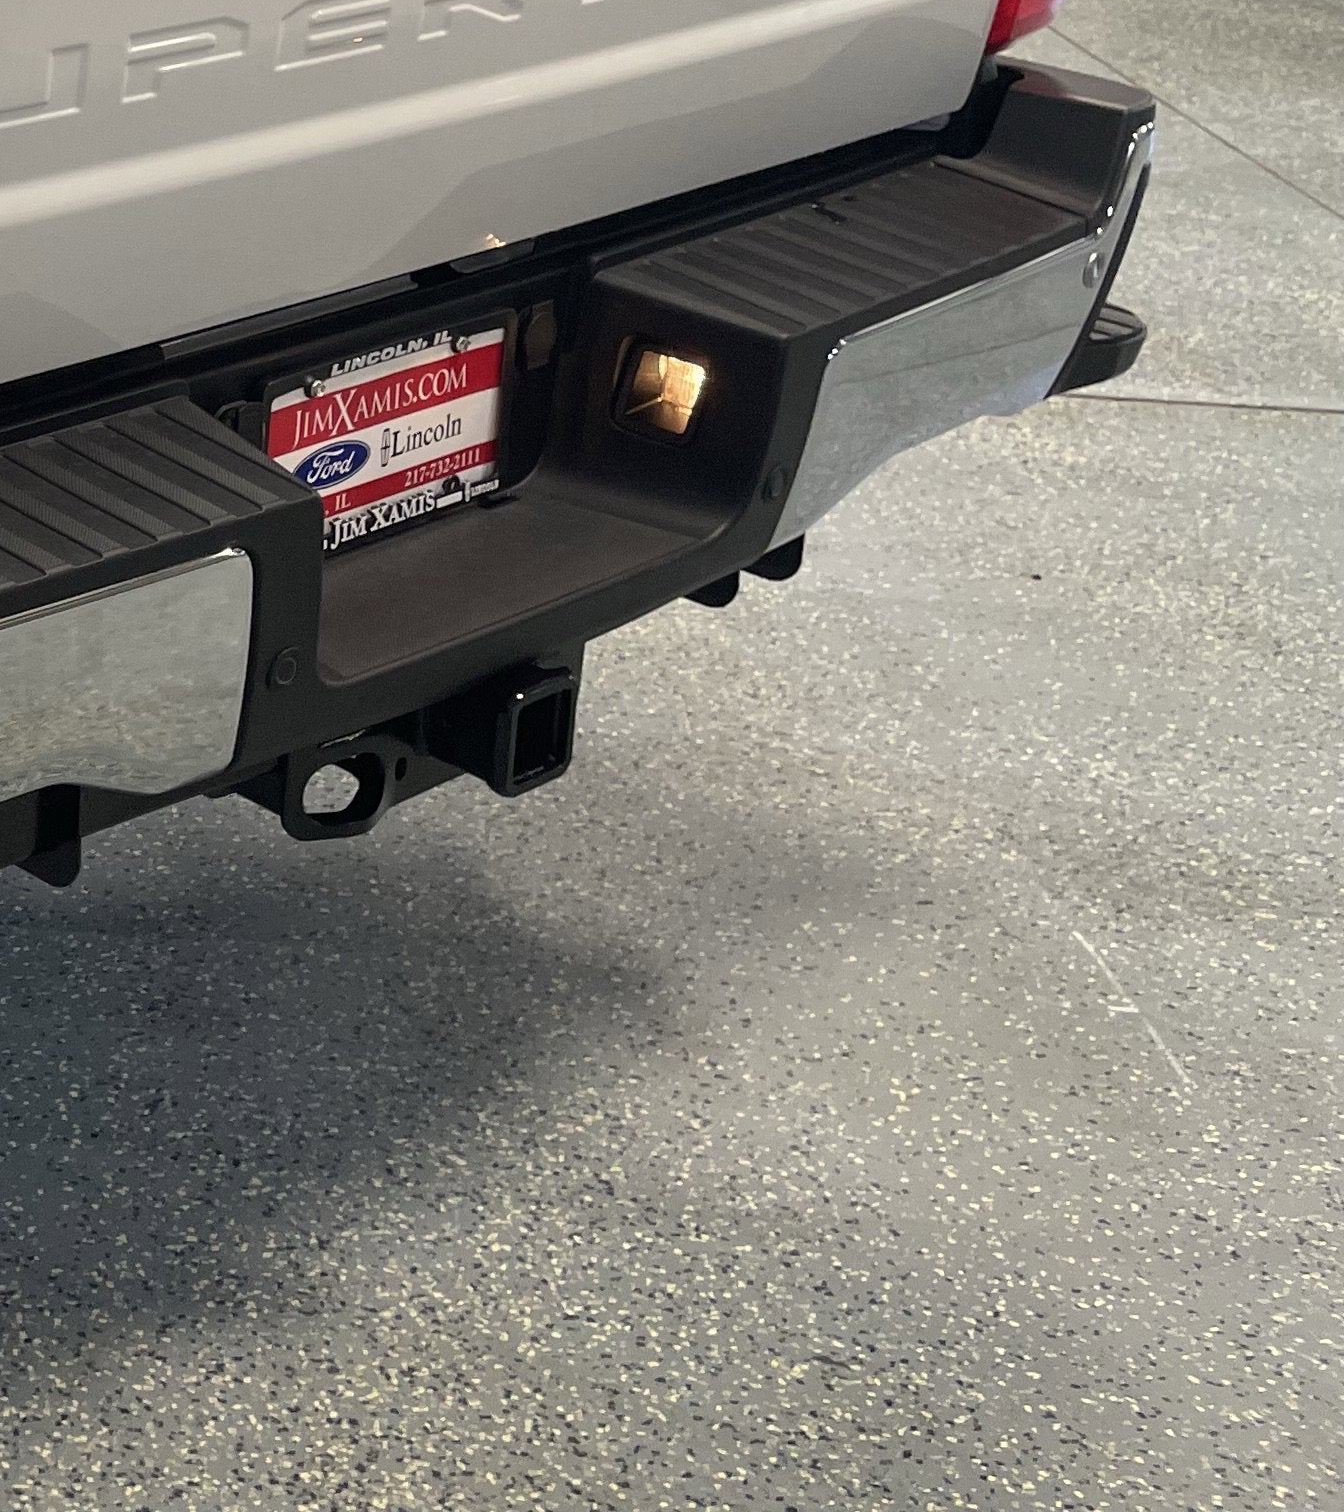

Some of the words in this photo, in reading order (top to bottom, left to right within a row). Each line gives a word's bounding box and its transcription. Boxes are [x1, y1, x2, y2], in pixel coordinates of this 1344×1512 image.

[432, 330, 452, 347] IL
[390, 413, 462, 458] Lincoln
[306, 447, 357, 484] Ford
[404, 447, 481, 488] 217-732-2111
[330, 514, 368, 550] JIM
[369, 491, 436, 532] XAMIS
[335, 493, 352, 511] IL
